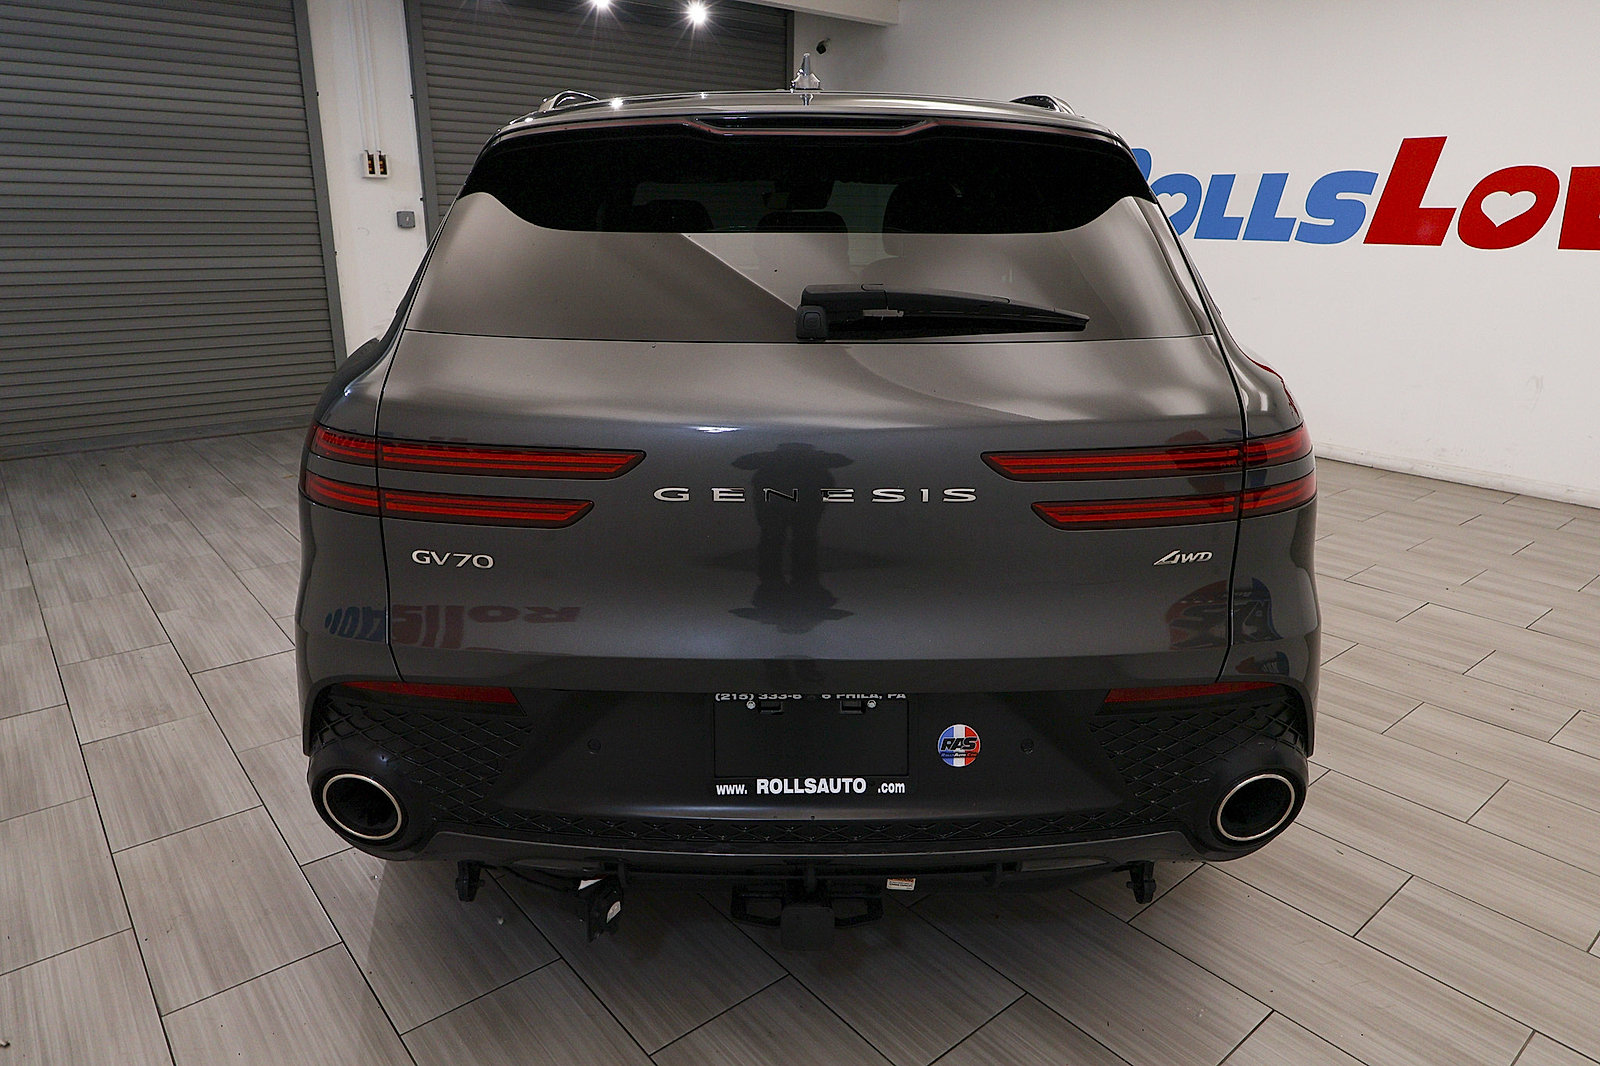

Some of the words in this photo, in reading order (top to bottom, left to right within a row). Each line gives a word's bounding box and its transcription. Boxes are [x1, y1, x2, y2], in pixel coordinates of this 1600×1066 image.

[653, 487, 977, 503] GENESIS
[411, 549, 495, 569] GV70
[1153, 549, 1213, 566] 4WD
[940, 736, 978, 751] RAS
[716, 783, 748, 796] www.
[756, 777, 867, 795] ROLLSAUTO
[877, 782, 906, 794] .com
